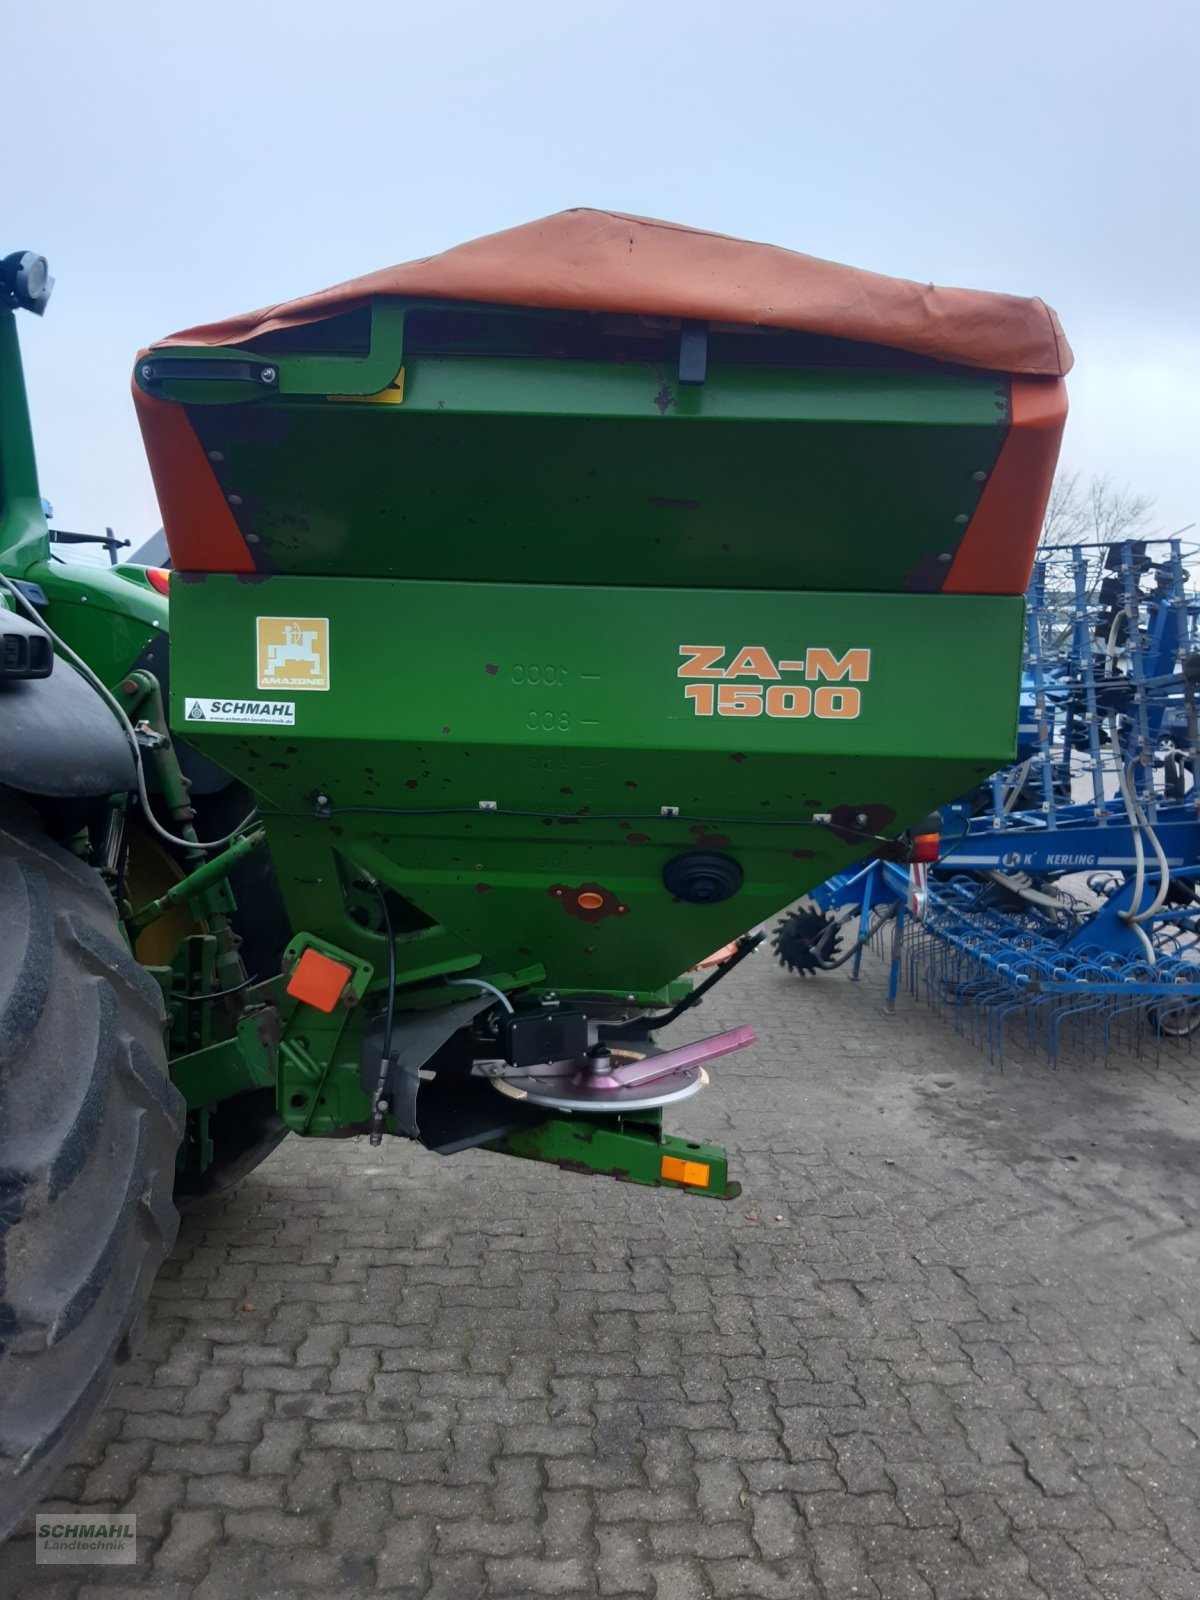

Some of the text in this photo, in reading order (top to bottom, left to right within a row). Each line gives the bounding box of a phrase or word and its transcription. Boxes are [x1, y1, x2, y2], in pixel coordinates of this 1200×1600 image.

[677, 645, 871, 681] ZA-M
[261, 677, 325, 686] AMAZONE
[210, 701, 293, 716] SCHMAHL
[684, 684, 861, 719] 1500
